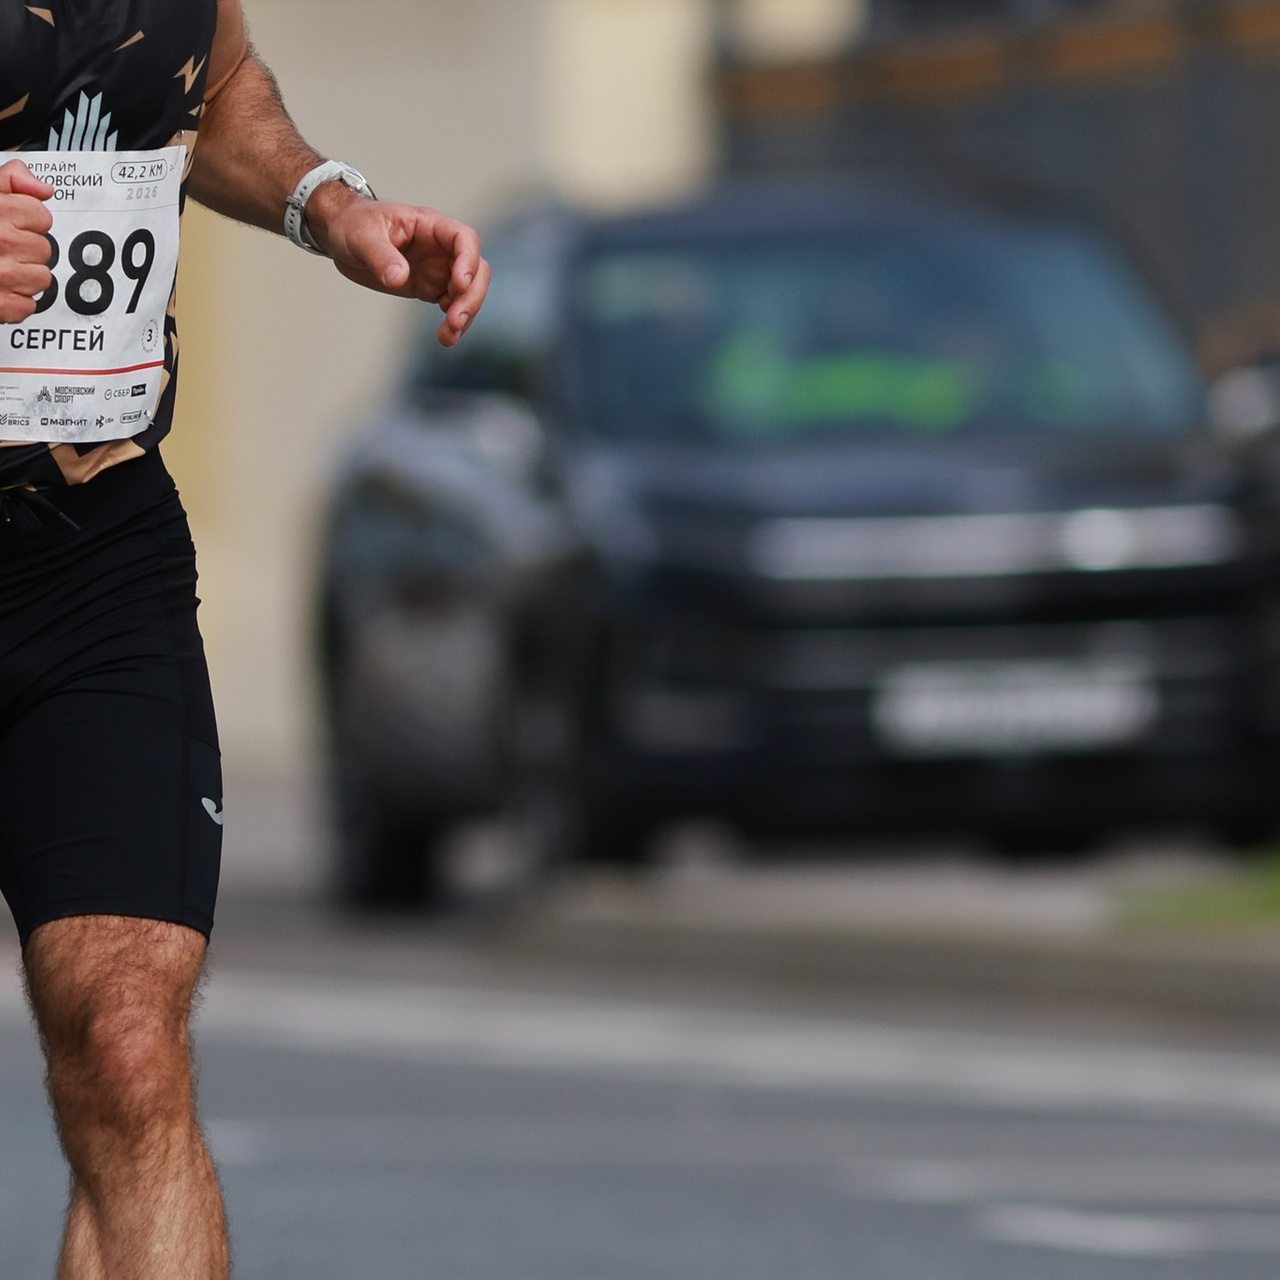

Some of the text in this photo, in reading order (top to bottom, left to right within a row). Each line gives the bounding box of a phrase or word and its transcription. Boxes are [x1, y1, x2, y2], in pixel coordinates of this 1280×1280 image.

[28, 161, 77, 172] РПРАЙМ
[118, 163, 163, 180] 42,2 КМ
[10, 324, 105, 351] СЕРГЕЙ
[146, 328, 153, 342] 3
[54, 385, 96, 395] МОСКОВСКИЙ
[113, 388, 131, 398] СБЕР
[54, 395, 74, 404] СПОРТ
[49, 417, 88, 426] магнит
